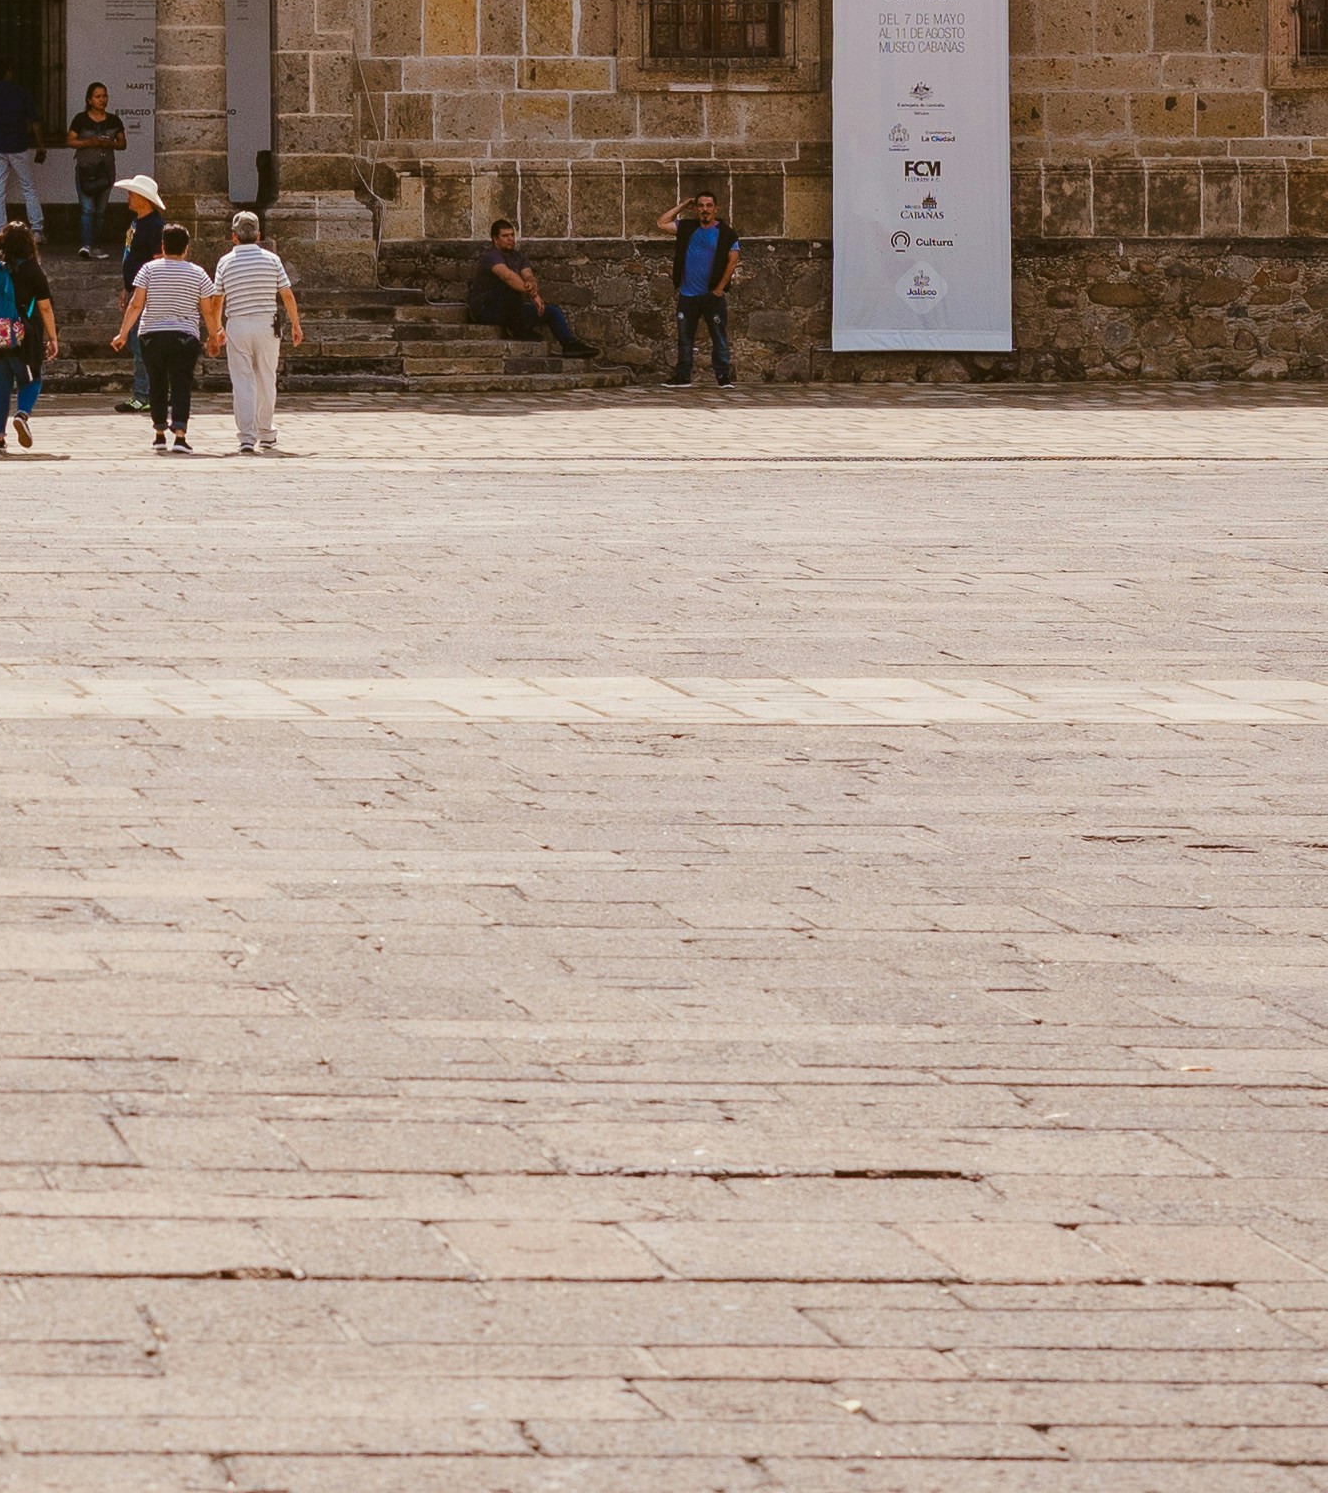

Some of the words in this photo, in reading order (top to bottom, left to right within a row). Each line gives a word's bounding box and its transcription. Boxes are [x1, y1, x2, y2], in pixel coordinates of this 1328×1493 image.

[878, 13, 900, 25] DEL
[904, 13, 911, 25] 7
[916, 13, 930, 25] DE
[933, 13, 965, 25] MAYO
[878, 27, 891, 39] AL
[895, 27, 906, 39] 11
[910, 27, 924, 39] DE
[925, 27, 965, 39] AGOSTO
[878, 41, 916, 53] MUSEO
[918, 40, 965, 53] CABAÑAS
[904, 160, 941, 177] FCM
[915, 238, 954, 247] Cultura
[906, 288, 937, 296] Jalisco
